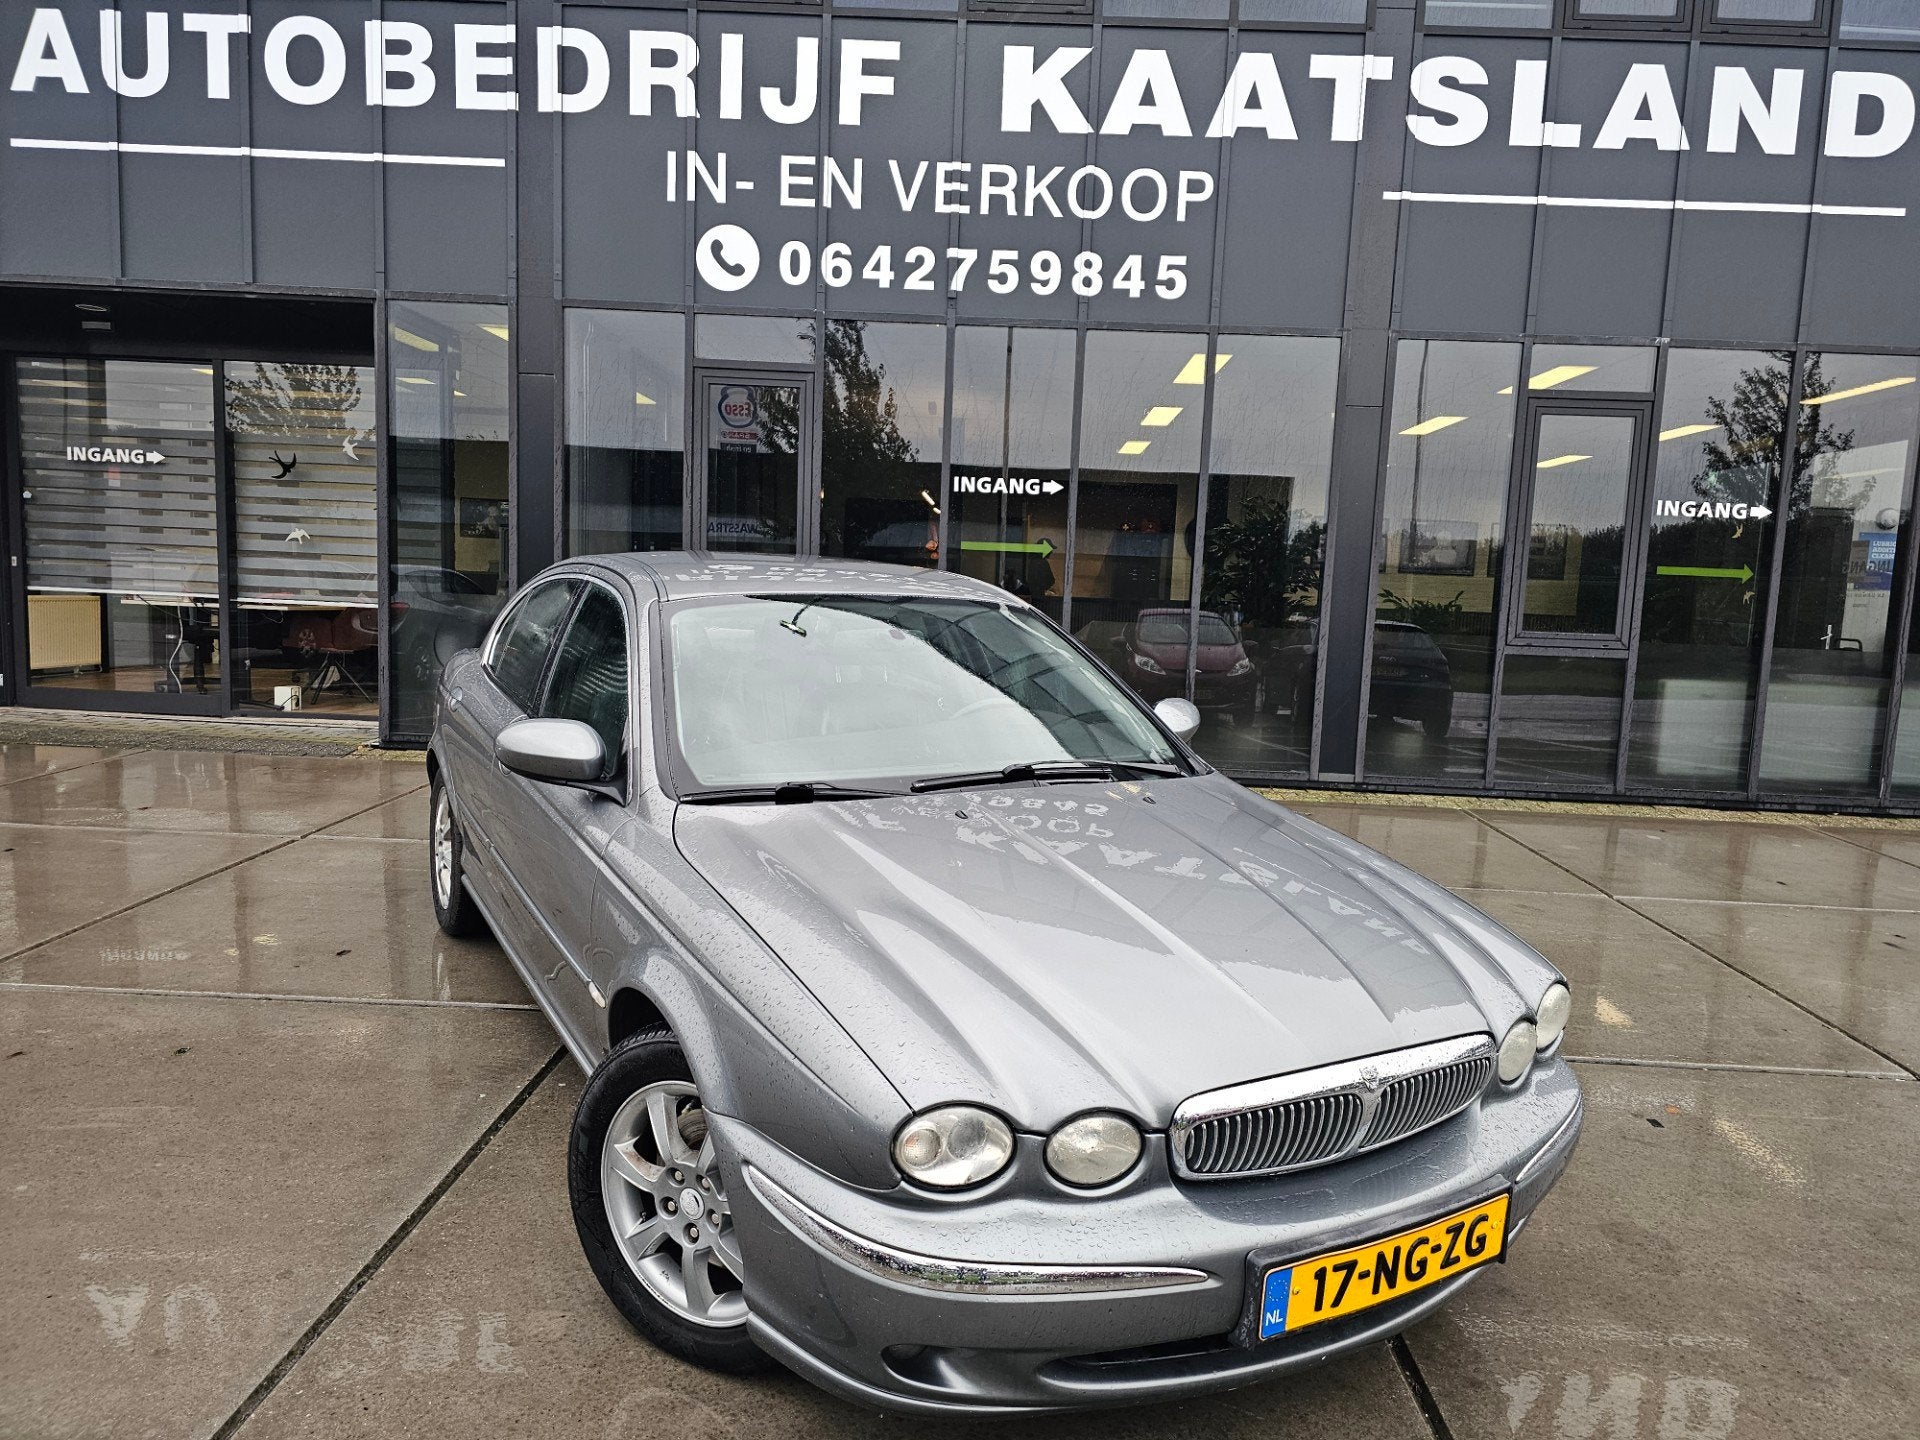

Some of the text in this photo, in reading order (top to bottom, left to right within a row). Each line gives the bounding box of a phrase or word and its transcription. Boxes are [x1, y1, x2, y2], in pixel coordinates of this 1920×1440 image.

[11, 9, 1916, 158] AUTOBEDRIJF KAATSLAND
[667, 151, 1214, 222] IN- EN VERKOOP
[779, 240, 1188, 300] 0642759845
[66, 447, 144, 463] INGANG
[953, 476, 1040, 495] INGANG
[1656, 500, 1748, 519] INGANG
[1265, 1213, 1490, 1327] NL 17-NG-ZG
